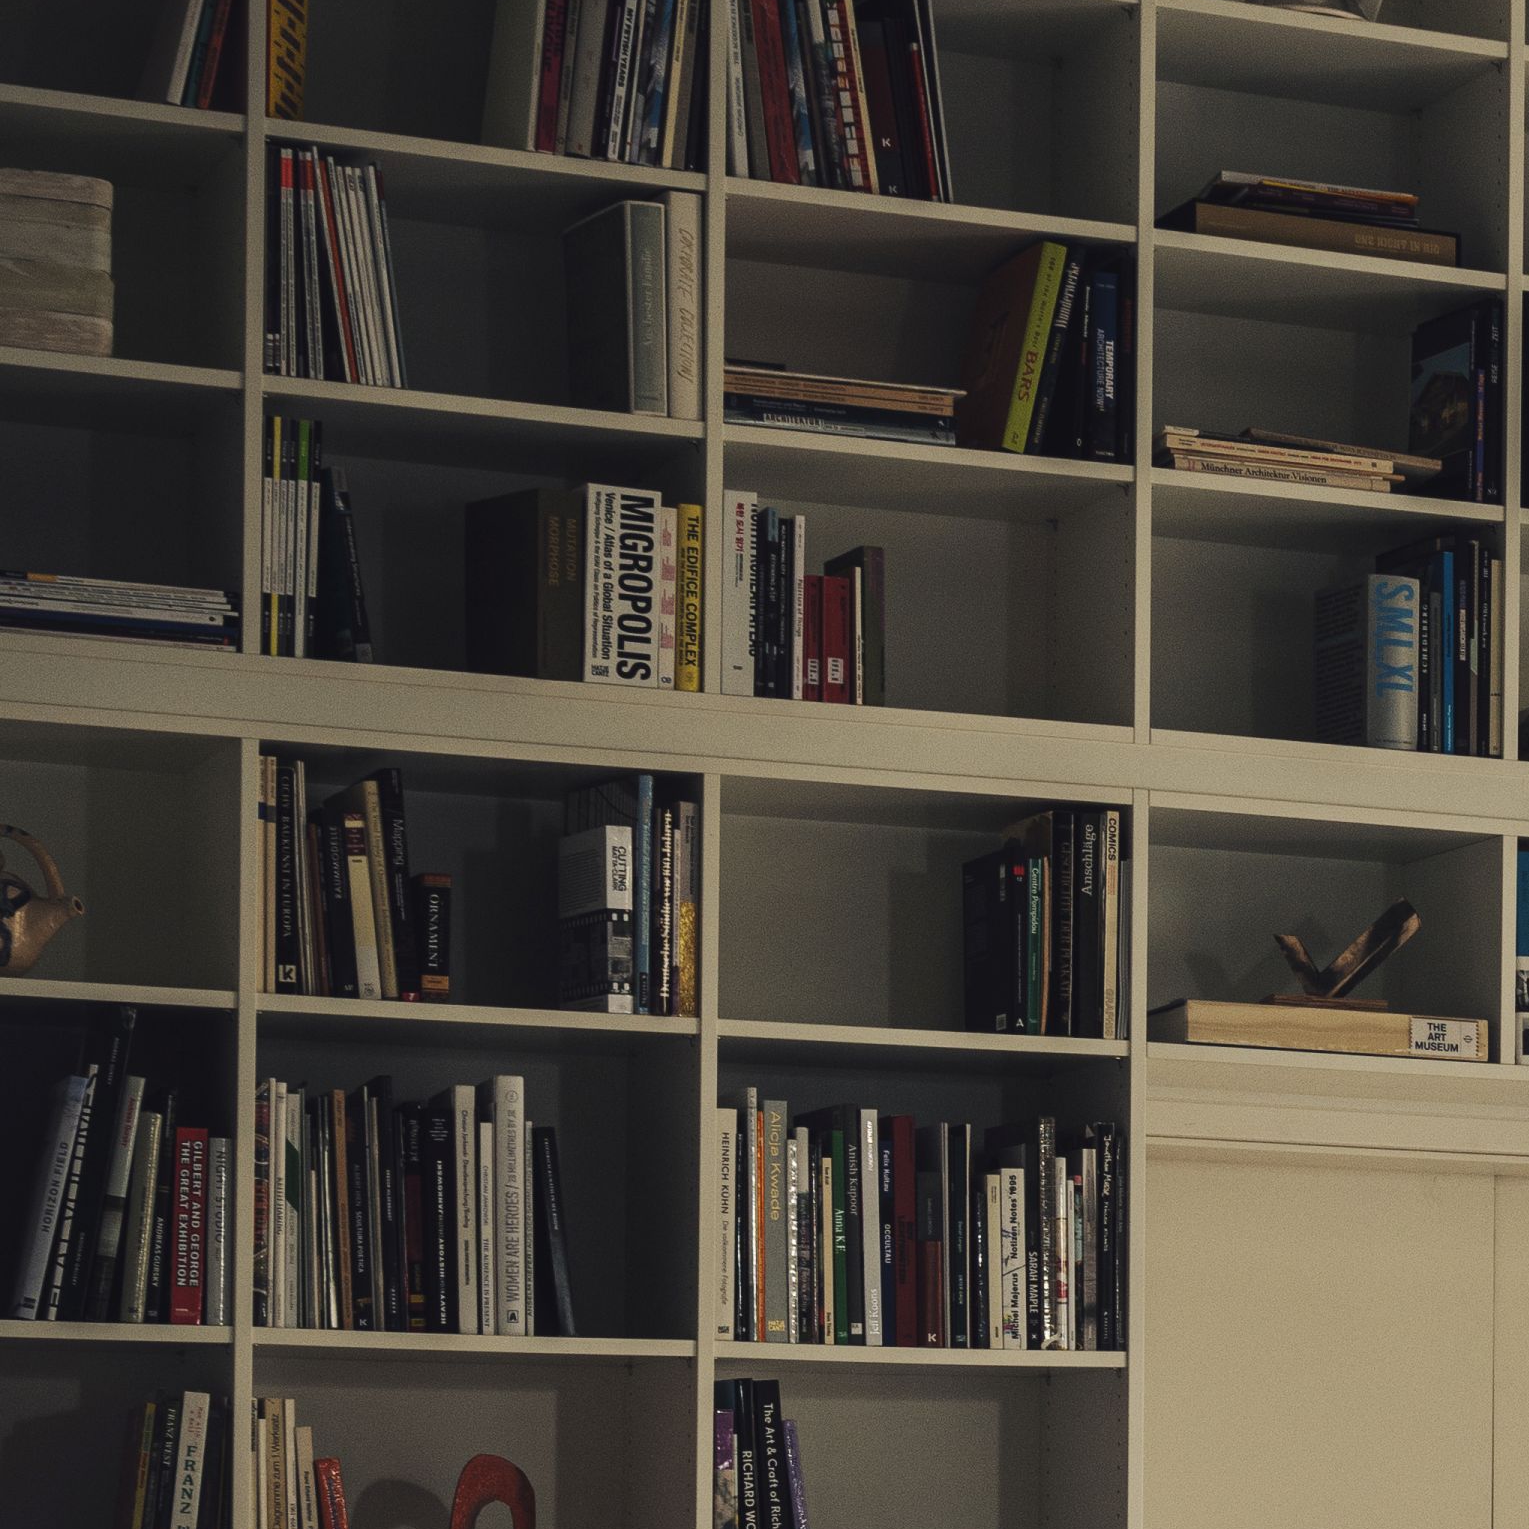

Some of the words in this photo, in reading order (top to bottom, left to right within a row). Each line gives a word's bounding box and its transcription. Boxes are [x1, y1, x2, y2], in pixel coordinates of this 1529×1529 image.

[626, 8, 634, 21] MY
[622, 24, 632, 55] FETISH
[618, 57, 628, 87] YEARS
[1105, 340, 1114, 400] TEMPORARY
[605, 493, 615, 523] Venice
[688, 516, 699, 541] THE
[604, 534, 614, 558] Atlas
[604, 561, 614, 570] of
[687, 547, 698, 597] EDIFICE
[603, 582, 613, 612] Global
[617, 494, 654, 681] MIGROPOLIS
[602, 615, 612, 660] Situation
[685, 603, 697, 666] COMPLEX
[393, 819, 405, 865] Mapping
[1108, 818, 1116, 860] COMICS
[618, 846, 626, 891] CUTTING
[1081, 823, 1096, 896] Anschläge
[1031, 868, 1039, 894] Centre
[1030, 896, 1039, 934] Pompidou
[1427, 1023, 1447, 1032] THE
[1427, 1033, 1446, 1042] ART
[1415, 1042, 1459, 1052] MUSEUM
[125, 1097, 135, 1123] Andreas
[121, 1124, 132, 1148] Gursky
[769, 1111, 781, 1156] Alicja
[181, 1141, 190, 1164] THE
[721, 1132, 730, 1180] HEINRICH
[848, 1144, 858, 1174] Anish
[192, 1141, 202, 1197] GILBERT
[42, 1180, 60, 1233] HORIZON
[54, 1142, 68, 1175] FIELD
[179, 1169, 189, 1209] GREAT
[721, 1185, 730, 1214] KÜHN
[771, 1162, 781, 1221] Kwade
[848, 1178, 858, 1216] Kapoor
[191, 1202, 200, 1228] AND
[154, 1217, 164, 1255] ANDREAS
[177, 1214, 188, 1286] EXHIBITION
[884, 1224, 892, 1263] OCCULTAU
[151, 1256, 161, 1286] GURSKY
[190, 1234, 199, 1286] GEORGE
[1028, 1252, 1038, 1281] SARAH
[870, 1289, 879, 1317] Koons
[1028, 1284, 1038, 1313] MAPLE
[870, 1320, 879, 1335] Jeff
[164, 1408, 175, 1439] FRANZ
[763, 1403, 774, 1424] The
[764, 1427, 775, 1443] Art
[163, 1441, 173, 1466] WEST
[766, 1447, 776, 1455] &
[181, 1445, 198, 1514] FRANZ
[742, 1451, 755, 1506] RICHARD
[767, 1458, 778, 1488] Craft
[769, 1491, 779, 1502] of
